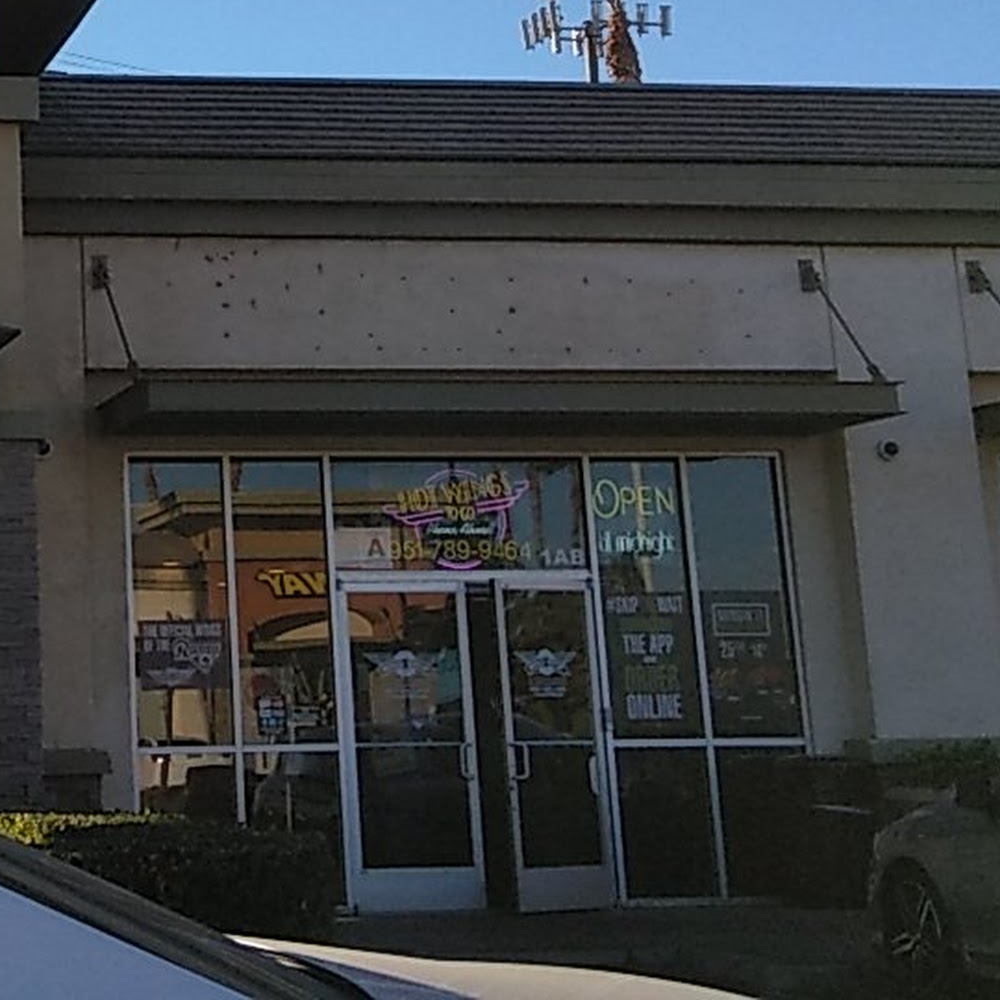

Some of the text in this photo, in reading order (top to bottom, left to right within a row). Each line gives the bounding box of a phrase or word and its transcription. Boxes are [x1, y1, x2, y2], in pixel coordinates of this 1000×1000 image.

[622, 633, 674, 655] THE APP
[626, 693, 683, 719] ONLINE
